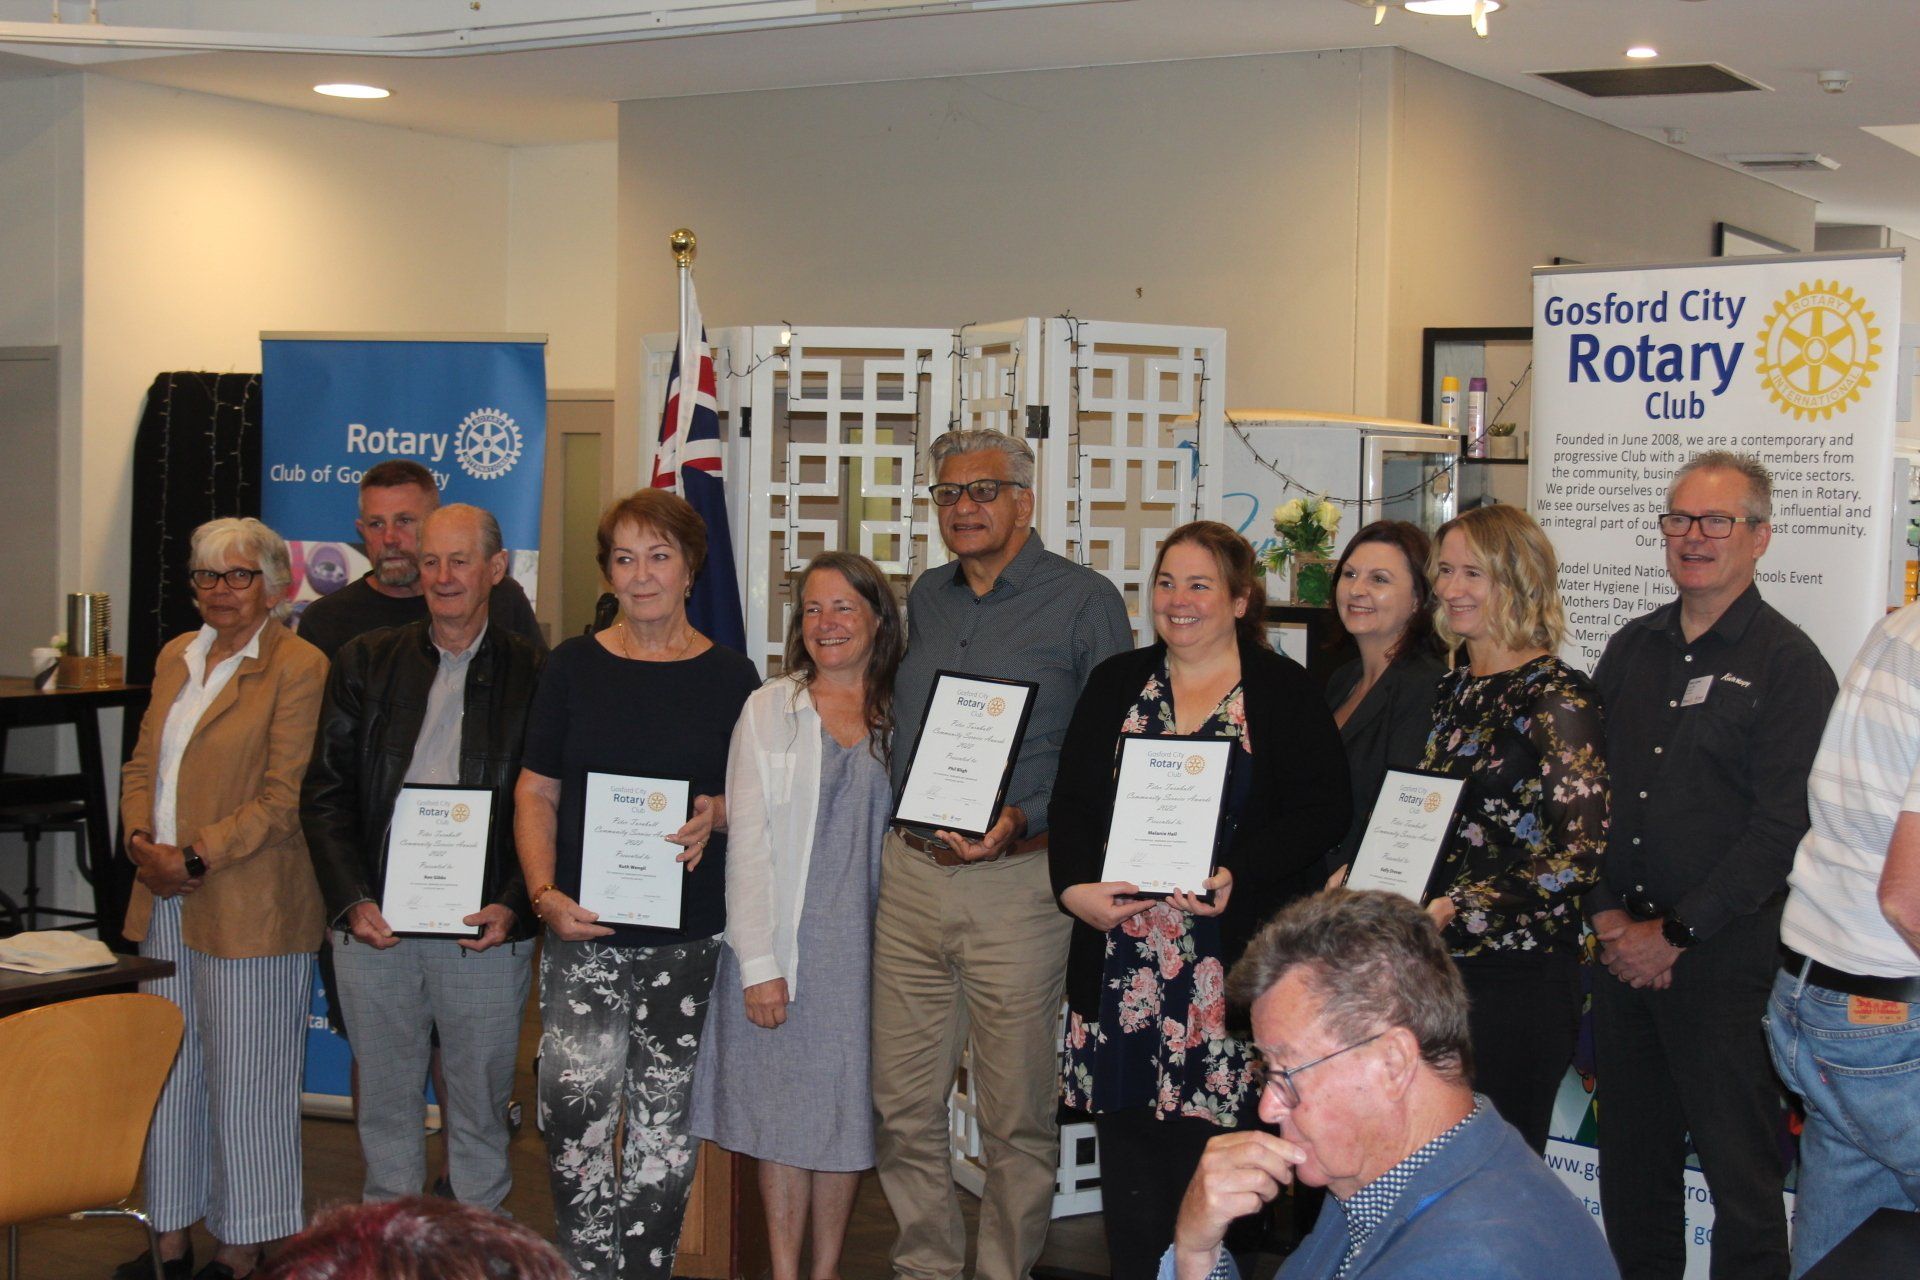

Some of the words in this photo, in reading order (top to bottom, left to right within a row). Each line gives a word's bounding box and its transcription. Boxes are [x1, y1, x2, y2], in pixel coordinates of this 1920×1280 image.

[1544, 290, 1668, 326] Gosford
[1680, 288, 1746, 329] City
[1792, 293, 1846, 314] ROTARY
[1568, 333, 1745, 396] Rotary
[1645, 391, 1705, 420] Club
[347, 423, 449, 462] Rotary
[1556, 433, 1604, 446] Founded
[1608, 434, 1618, 446] in
[1621, 434, 1648, 446] June
[1651, 433, 1683, 447] 2008,
[1686, 436, 1704, 446] we
[1707, 436, 1728, 446] are
[1731, 436, 1737, 446] a
[1741, 434, 1826, 448] contemporary
[1829, 433, 1854, 446] and
[1554, 450, 1618, 464] progressive
[1621, 450, 1647, 462] Club
[1650, 450, 1675, 463] with
[1678, 453, 1685, 463] a
[1764, 451, 1819, 464] members
[1823, 451, 1854, 463] from
[270, 463, 306, 483] Club
[311, 464, 332, 483] of
[1552, 467, 1569, 478] the
[1573, 467, 1640, 481] community,
[1643, 468, 1681, 480] busine
[1767, 470, 1803, 482] ervice
[1806, 470, 1855, 482] sectors.
[1546, 483, 1563, 495] We
[1566, 483, 1595, 497] pride
[1598, 484, 1652, 496] ourselves
[1802, 487, 1812, 499] in
[1817, 487, 1861, 502] Rotary.
[1537, 499, 1552, 511] We
[1555, 502, 1573, 511] see
[1576, 500, 1630, 512] ourselves
[1633, 504, 1645, 513] as
[1780, 504, 1841, 517] influential
[1845, 506, 1871, 518] and
[1540, 517, 1552, 527] an
[1555, 516, 1597, 530] integral
[1600, 518, 1624, 531] part
[1627, 517, 1640, 530] of
[1792, 523, 1867, 538] community.
[1635, 534, 1657, 547] Our
[1593, 563, 1631, 576] United
[1634, 565, 1672, 578] Nation
[1754, 569, 1786, 583] hools
[1789, 571, 1823, 585] Event
[1593, 580, 1640, 595] Hygiene
[1561, 595, 1609, 609] Mothers
[1613, 597, 1634, 612] Day
[1569, 612, 1611, 626] Central
[957, 696, 986, 710] Rotary
[1149, 758, 1182, 770] Rotary
[613, 793, 646, 806] Rotary
[1398, 792, 1424, 807] Rotary
[419, 807, 449, 818] Rotary
